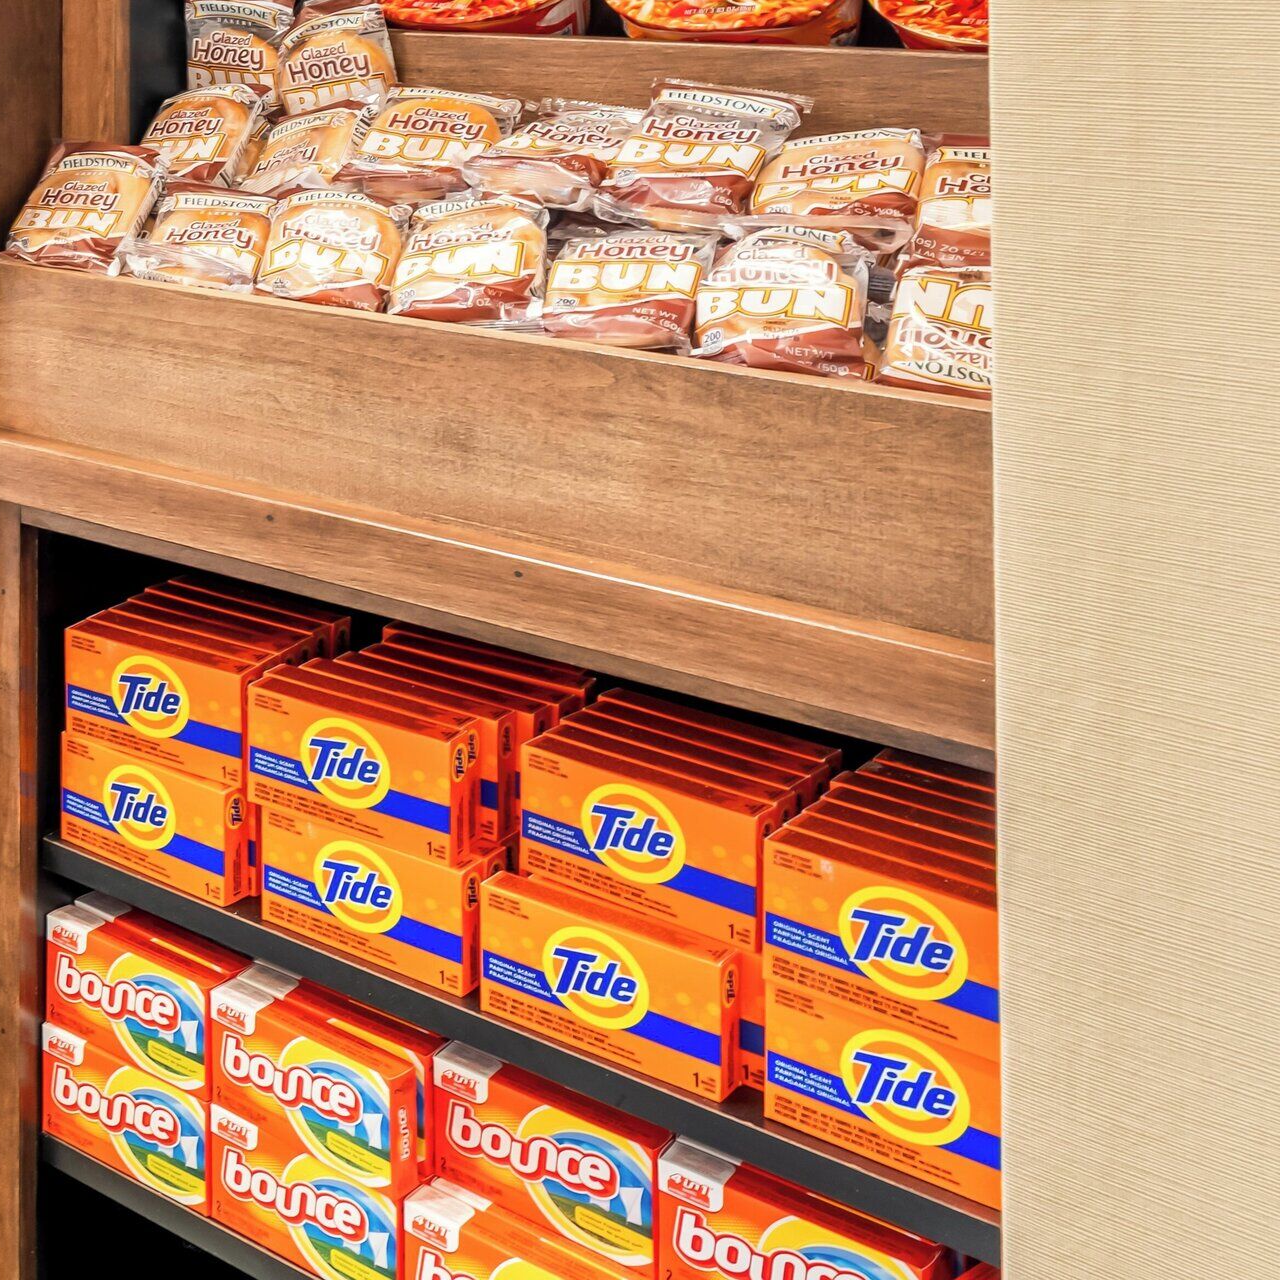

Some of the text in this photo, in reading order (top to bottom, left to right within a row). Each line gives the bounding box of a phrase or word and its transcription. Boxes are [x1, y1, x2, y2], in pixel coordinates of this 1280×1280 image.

[199, 2, 269, 20] FIELDSTONE
[192, 37, 265, 71] Honey
[211, 31, 252, 47] Glazed
[301, 42, 347, 61] Glazed
[287, 52, 371, 86] Honey
[149, 116, 222, 137] Honey
[169, 108, 209, 120] Glazed
[387, 111, 486, 141] Honey
[415, 106, 469, 122] Glazed
[674, 116, 739, 129] Glazed
[358, 130, 490, 164] BUN
[645, 118, 760, 145] Honey
[62, 156, 132, 170] FIELDSTONE
[615, 136, 766, 180] BUN
[781, 155, 903, 180] Honey
[808, 150, 877, 166] Glazed
[40, 187, 119, 212] Honey
[63, 180, 108, 192] Glazed
[183, 196, 266, 210] FIELDSTONE
[17, 206, 122, 238] BUN
[189, 219, 240, 231] Glazed
[165, 226, 256, 250] Honey
[577, 242, 696, 264] Honey
[262, 239, 390, 281] BUN
[396, 241, 524, 288] BUN
[549, 260, 702, 298] BUN
[556, 298, 576, 306] 200
[631, 306, 679, 321] NET WT
[696, 283, 856, 327] BUN
[703, 331, 722, 344] 200
[785, 346, 809, 357] NET
[117, 673, 182, 716] Tide
[307, 736, 382, 785] Tide
[108, 782, 170, 828] Tide
[589, 802, 676, 859] Tide
[321, 858, 394, 910] Tide
[848, 907, 956, 974] Tide
[551, 945, 639, 1005] Tide
[54, 951, 181, 1033] bounce
[221, 1031, 365, 1125] bounce
[850, 1049, 958, 1120] Tide
[51, 1061, 181, 1149] bounce
[444, 1098, 621, 1201] bounce
[221, 1146, 370, 1245] bounce
